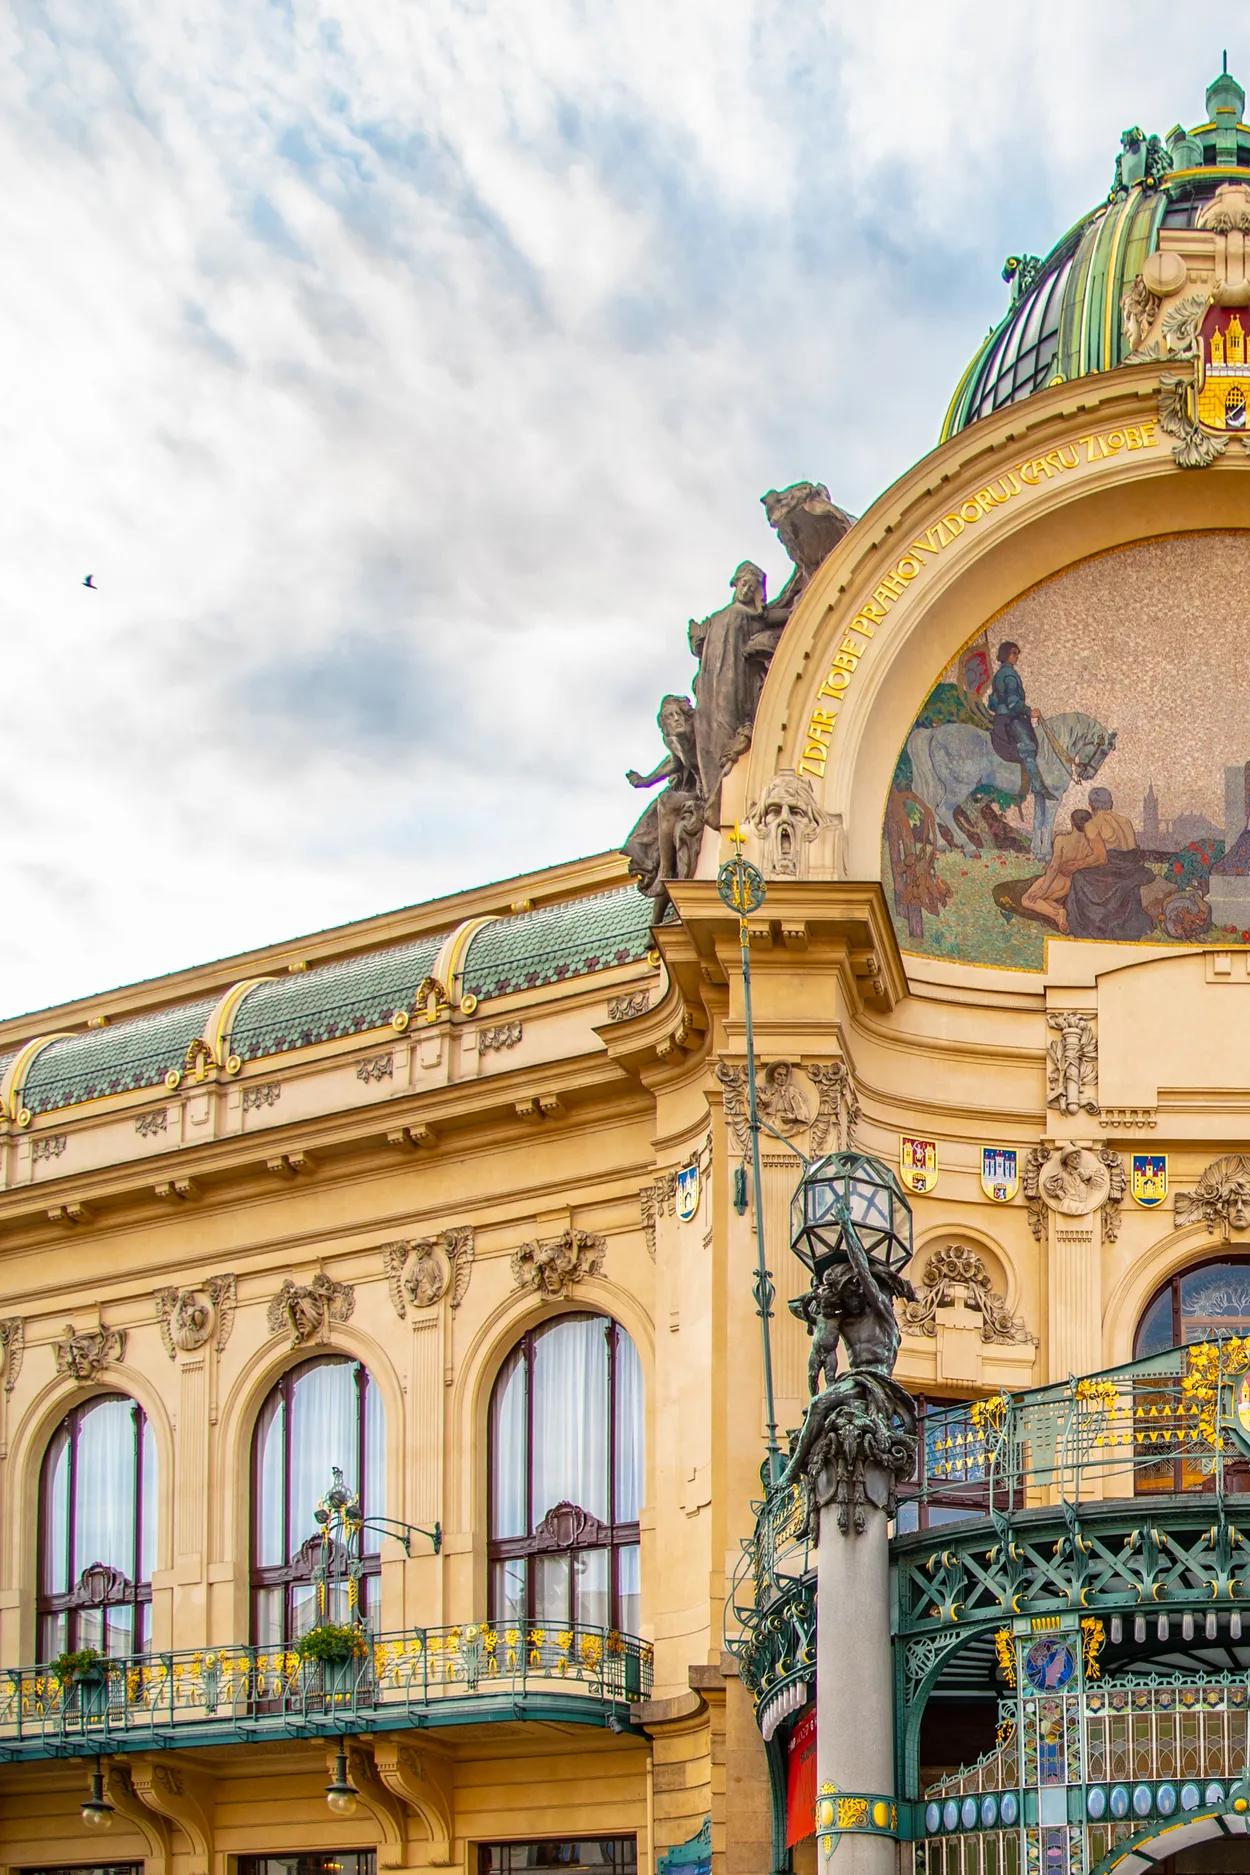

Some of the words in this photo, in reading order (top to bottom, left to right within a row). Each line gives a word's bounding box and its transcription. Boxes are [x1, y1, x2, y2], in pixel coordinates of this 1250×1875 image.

[795, 707, 838, 778] ZDAR
[849, 550, 927, 638] PRAHO!
[912, 473, 1022, 554] VZDORUJ
